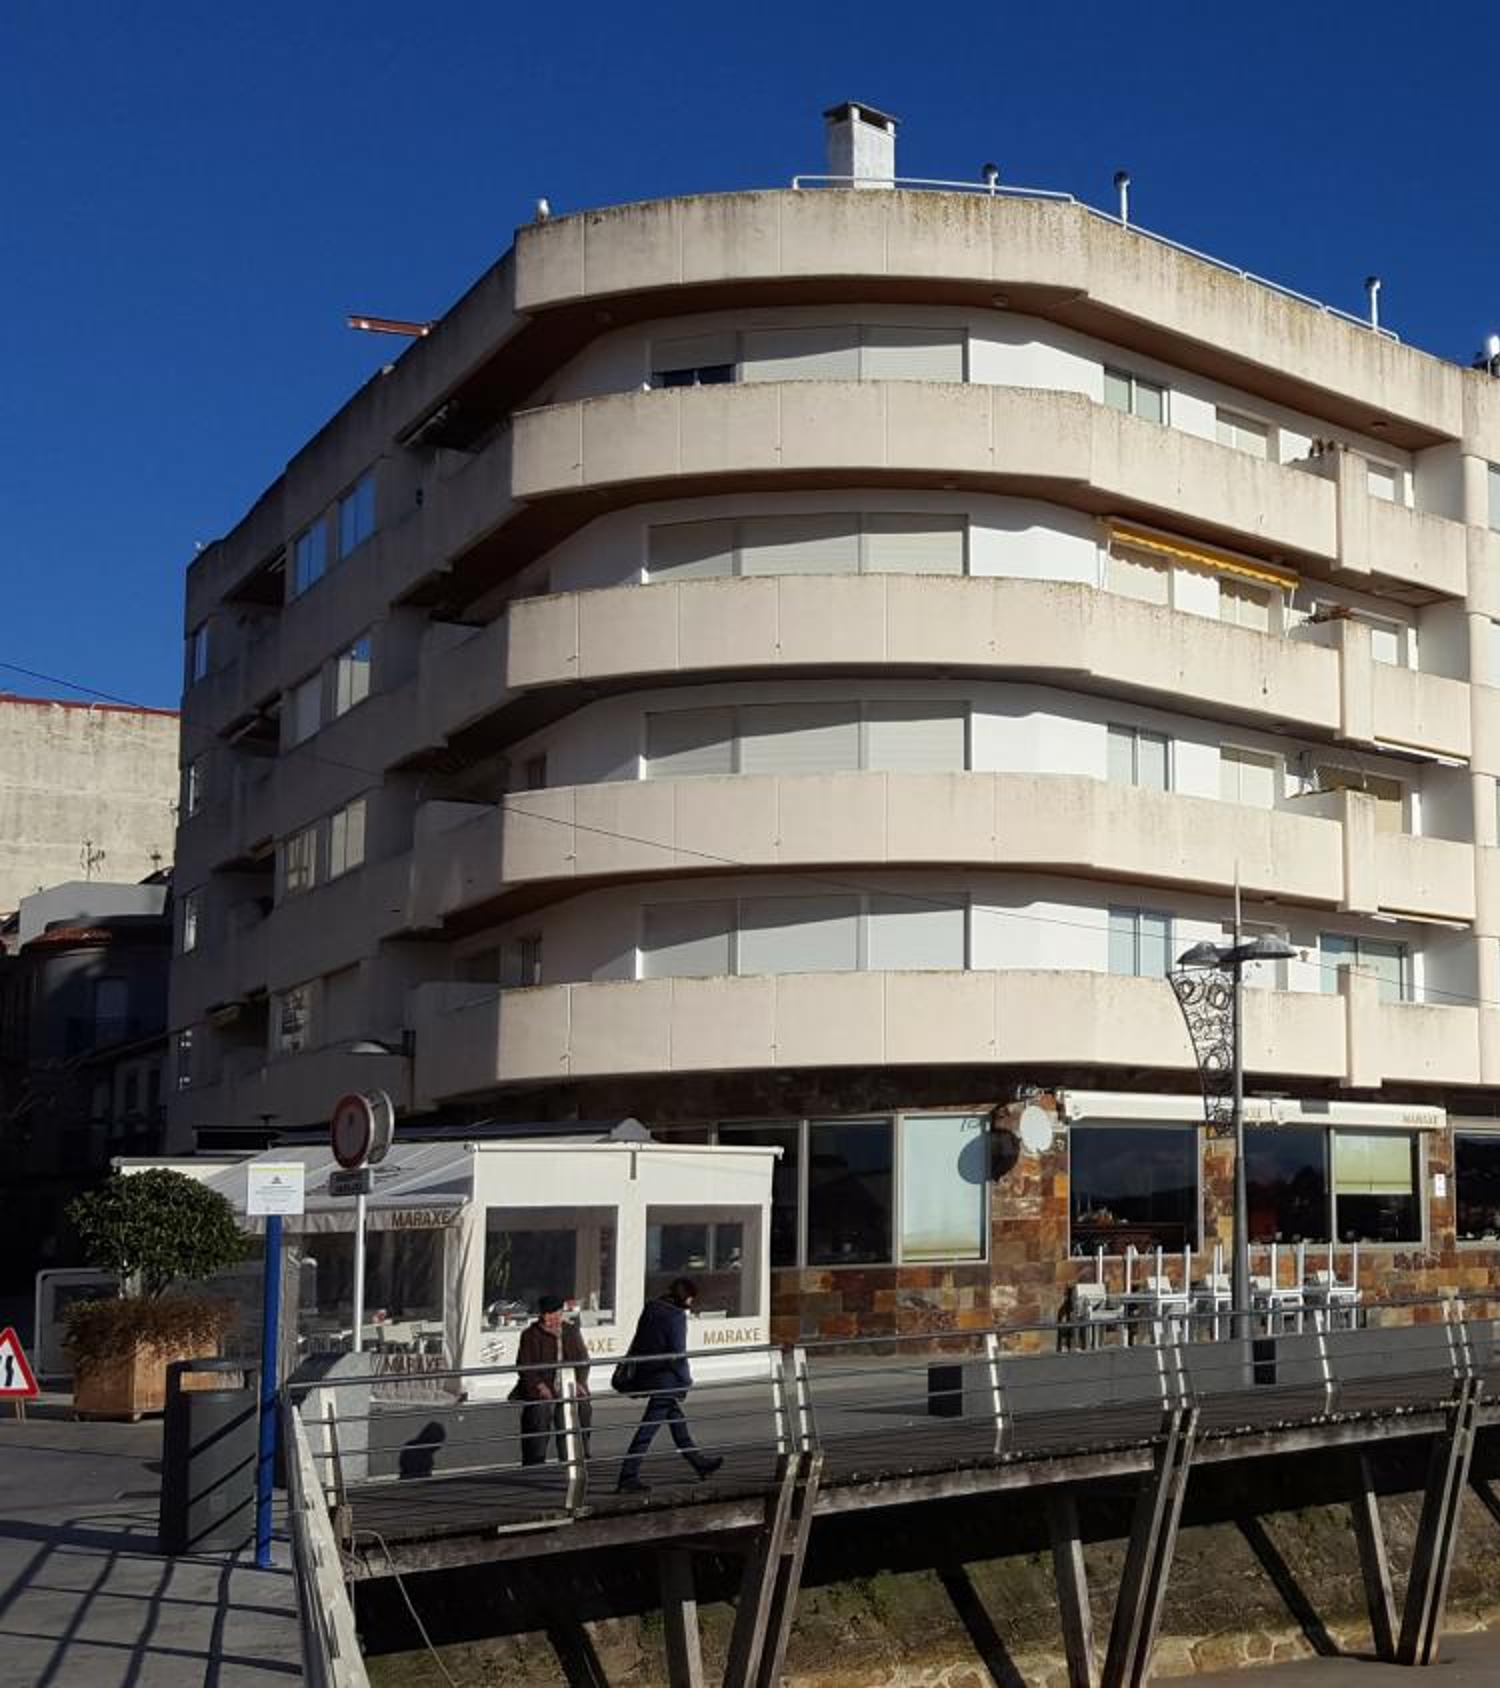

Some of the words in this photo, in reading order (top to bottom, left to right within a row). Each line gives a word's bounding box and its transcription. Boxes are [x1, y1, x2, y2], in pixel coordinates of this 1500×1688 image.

[391, 1209, 450, 1227] MARAXE
[586, 1336, 616, 1353] AXE
[703, 1328, 761, 1345] MARAXE
